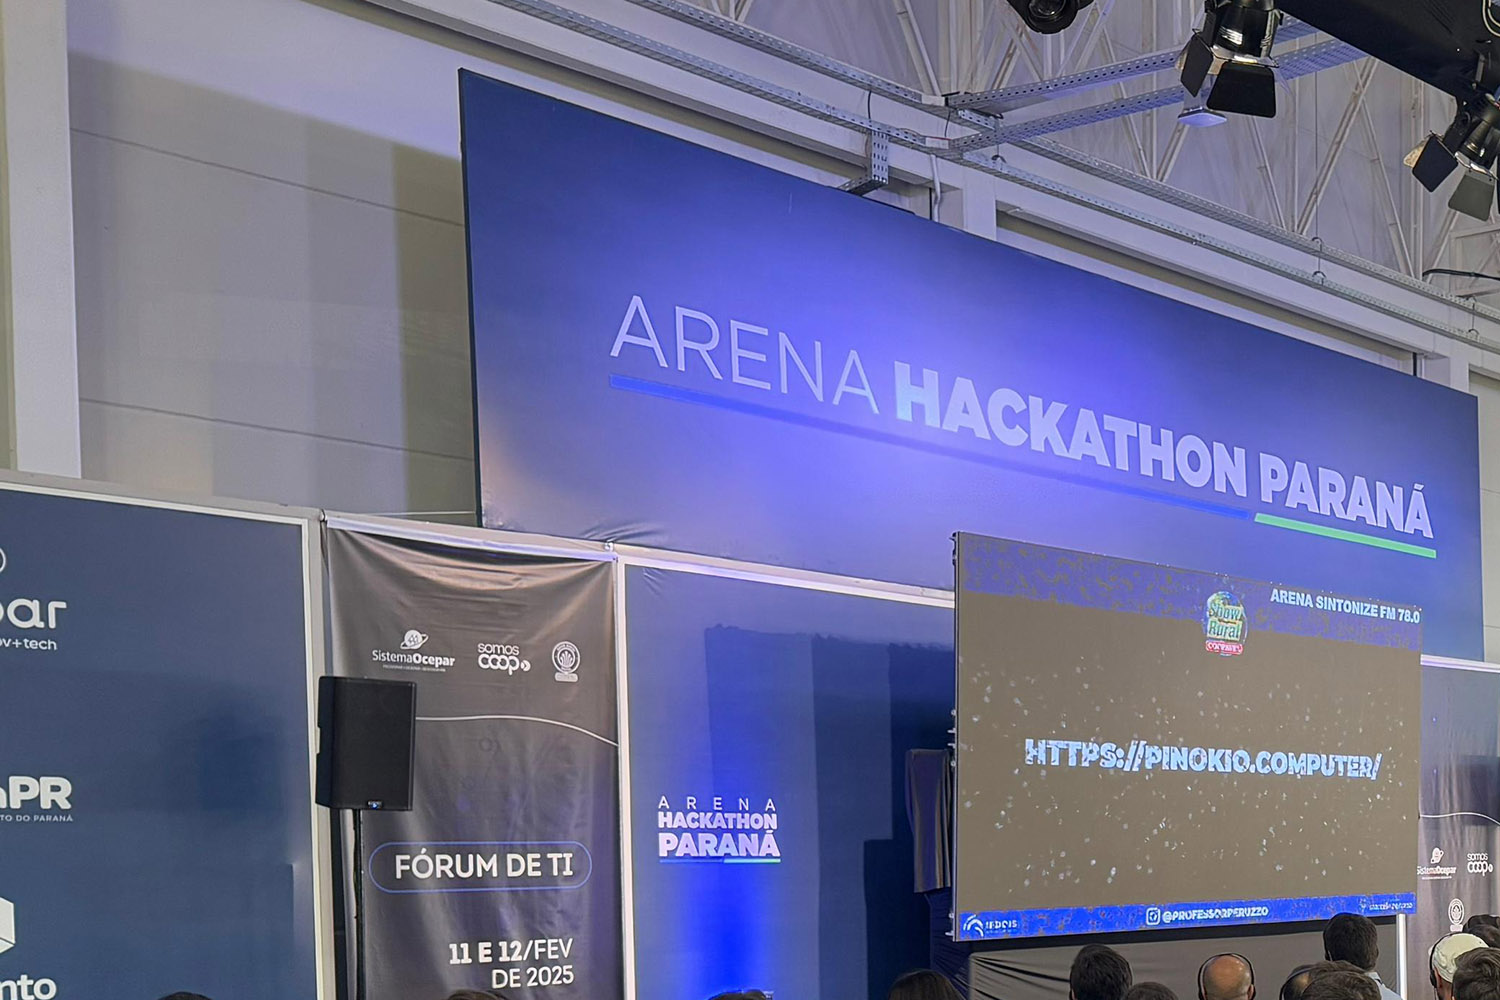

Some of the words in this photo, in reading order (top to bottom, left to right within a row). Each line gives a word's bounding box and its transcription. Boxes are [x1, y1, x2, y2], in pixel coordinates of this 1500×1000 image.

[610, 295, 880, 415] ARENA
[894, 360, 1248, 498] HACKATHON
[1259, 453, 1434, 539] PARANÁ
[1270, 588, 1313, 609] ARENA
[1315, 596, 1378, 618] SINTONIZE
[1380, 605, 1396, 621] FM
[1398, 608, 1420, 625] 78.0
[372, 649, 456, 668] SistemaOcepar
[478, 642, 520, 656] somos
[1025, 739, 1383, 780] HTTPS://PINOKIO.COMPUTER/
[658, 795, 776, 811] ARENA
[658, 811, 777, 829] HACKATHON
[659, 829, 780, 857] PARANÁ
[395, 847, 498, 879] FÓRUM
[506, 853, 542, 878] DE
[547, 852, 574, 876] TI
[449, 943, 472, 964] 11
[478, 942, 493, 963] E
[498, 938, 574, 962] 12/FEV
[492, 969, 521, 989] DE
[526, 965, 575, 987] 2025
